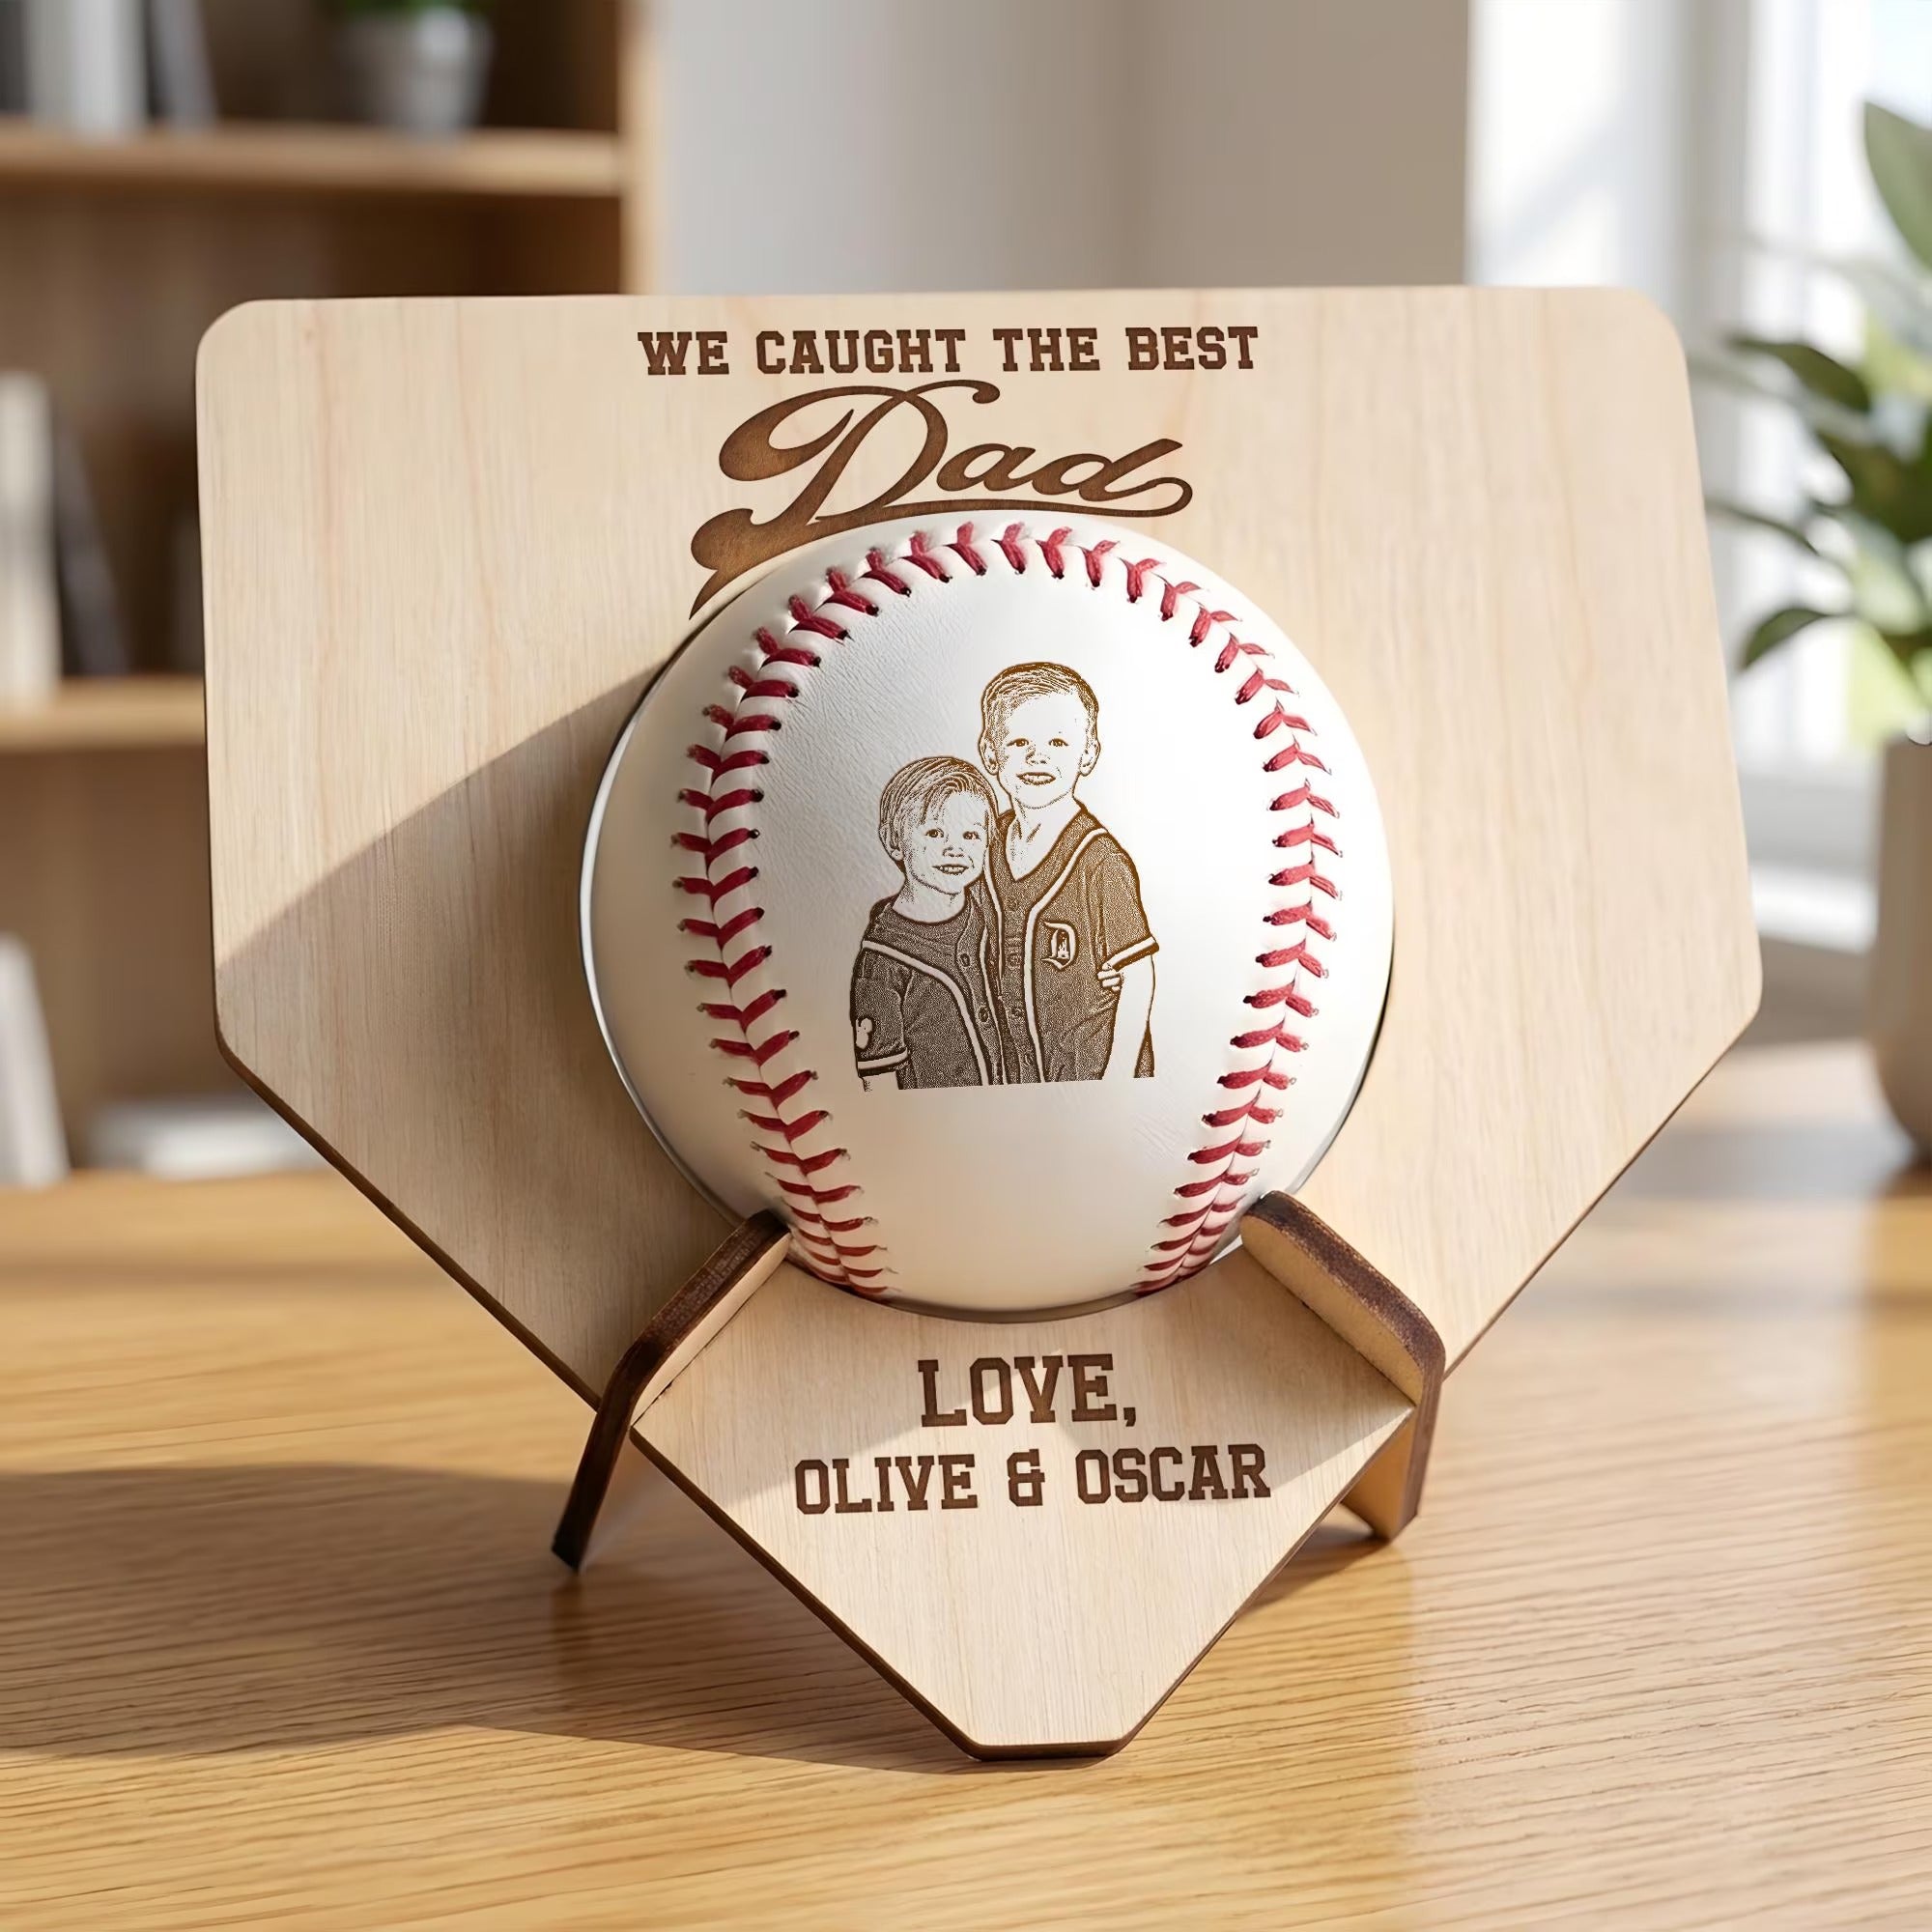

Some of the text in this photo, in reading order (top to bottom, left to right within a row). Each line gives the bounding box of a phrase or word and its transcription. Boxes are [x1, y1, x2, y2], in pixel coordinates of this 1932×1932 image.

[638, 326, 1259, 376] WE CAUGHT THE BEST
[690, 380, 1193, 620] Dad
[916, 1353, 1137, 1428] LOVE,
[794, 1443, 1271, 1516] OLIVE & OSCAR
